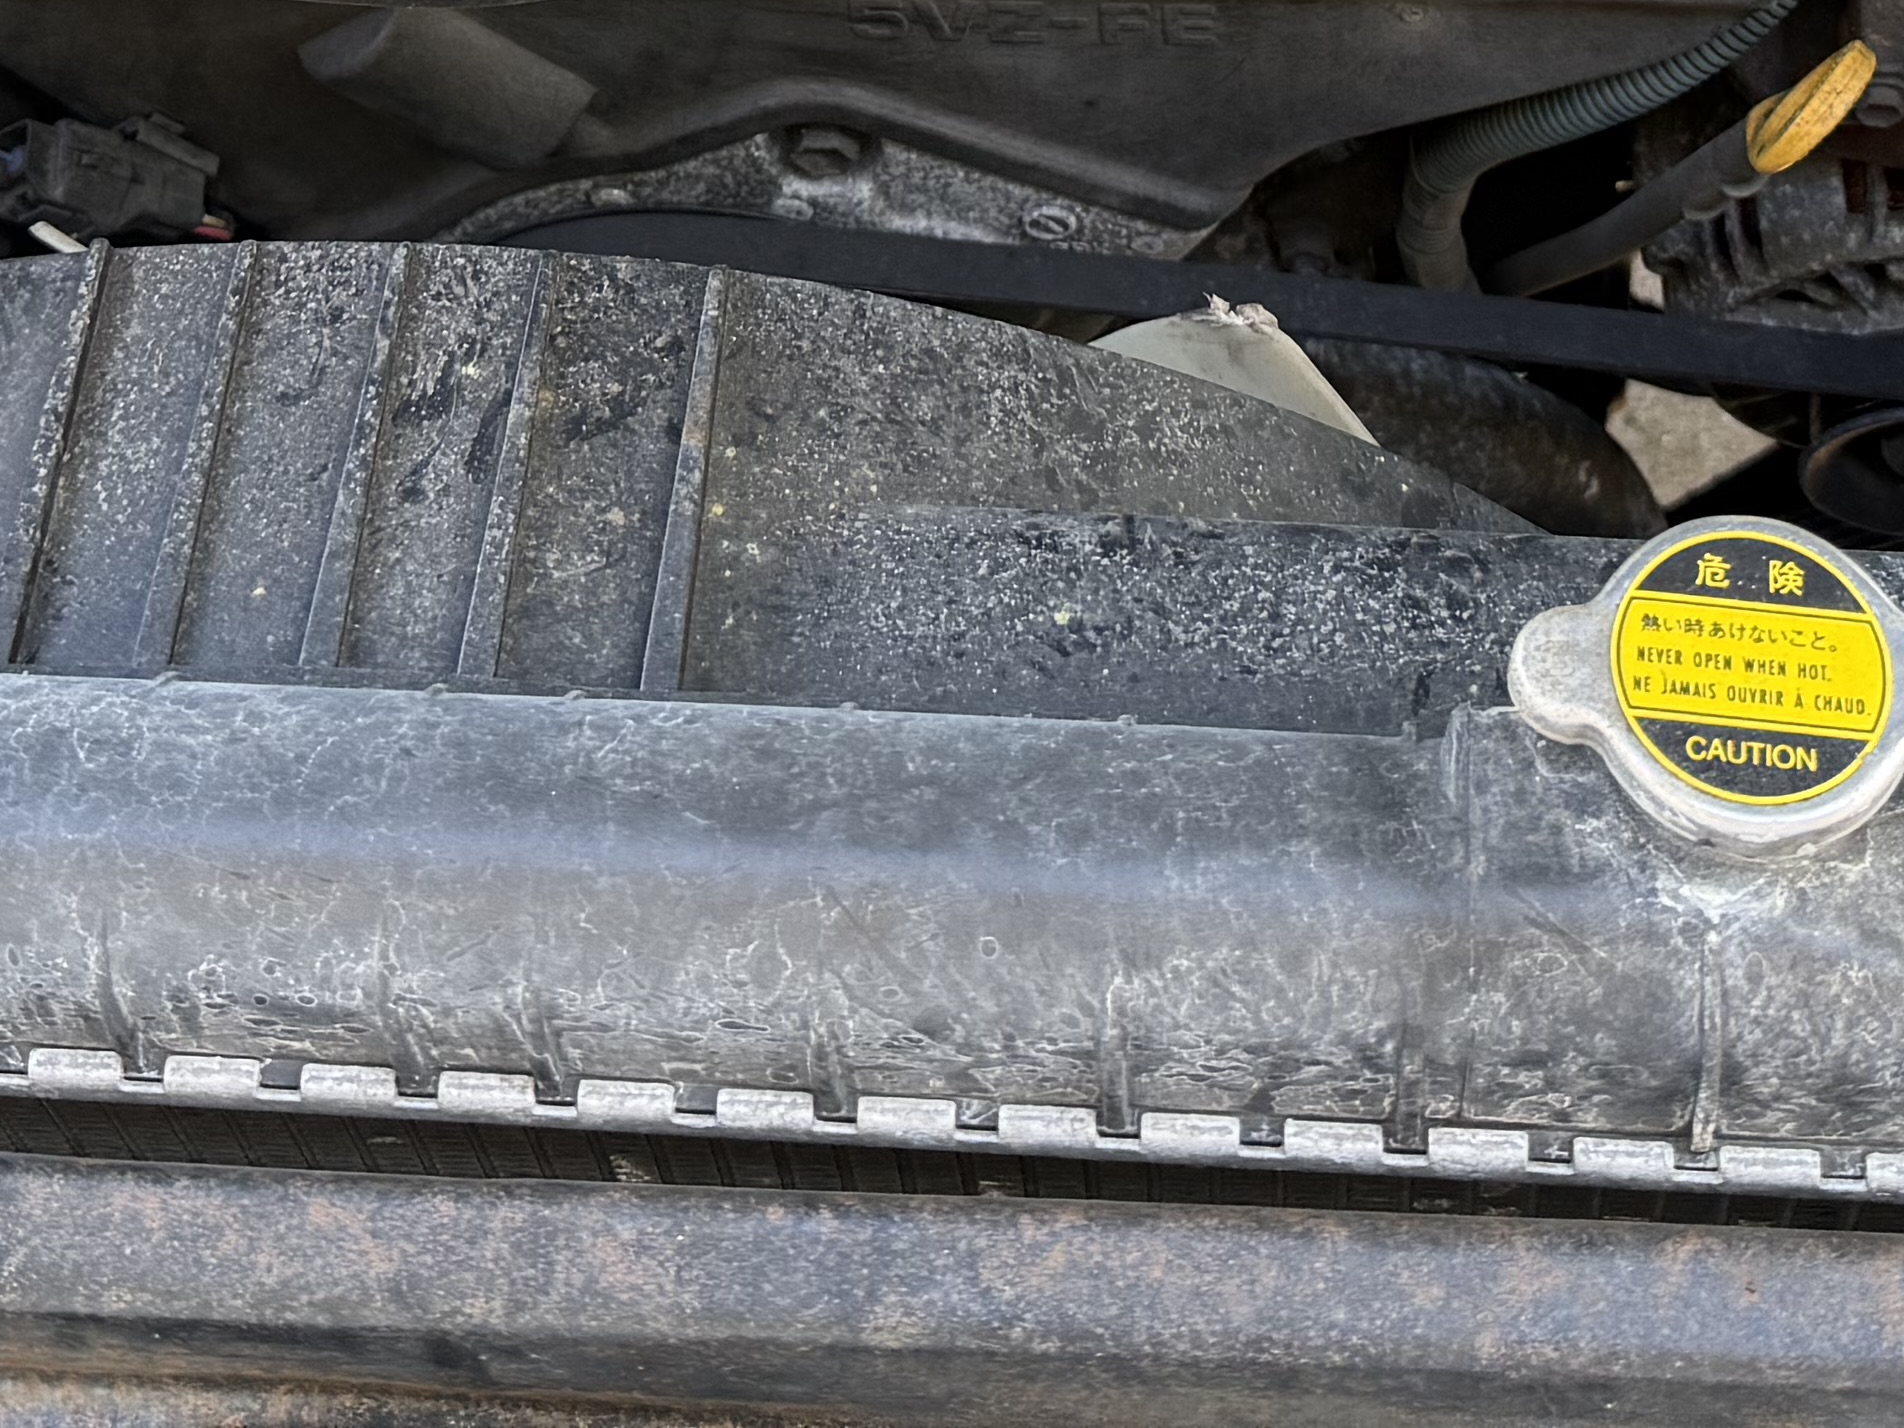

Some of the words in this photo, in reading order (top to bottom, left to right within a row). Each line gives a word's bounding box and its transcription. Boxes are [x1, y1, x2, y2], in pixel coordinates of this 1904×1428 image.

[1695, 552, 1807, 597] 危険
[1640, 612, 1838, 653] 熱い時あけないこと。
[1636, 645, 1684, 667] NEVER
[1693, 650, 1733, 672] OPEN
[1743, 654, 1789, 677] WHEN
[1797, 660, 1833, 682] HOT.
[1633, 674, 1652, 694] NE
[1660, 676, 1717, 701] JAMAIS
[1726, 684, 1785, 708] OUVRIR
[1813, 694, 1873, 717] CHAUD.
[1685, 735, 1819, 773] CAUTION
